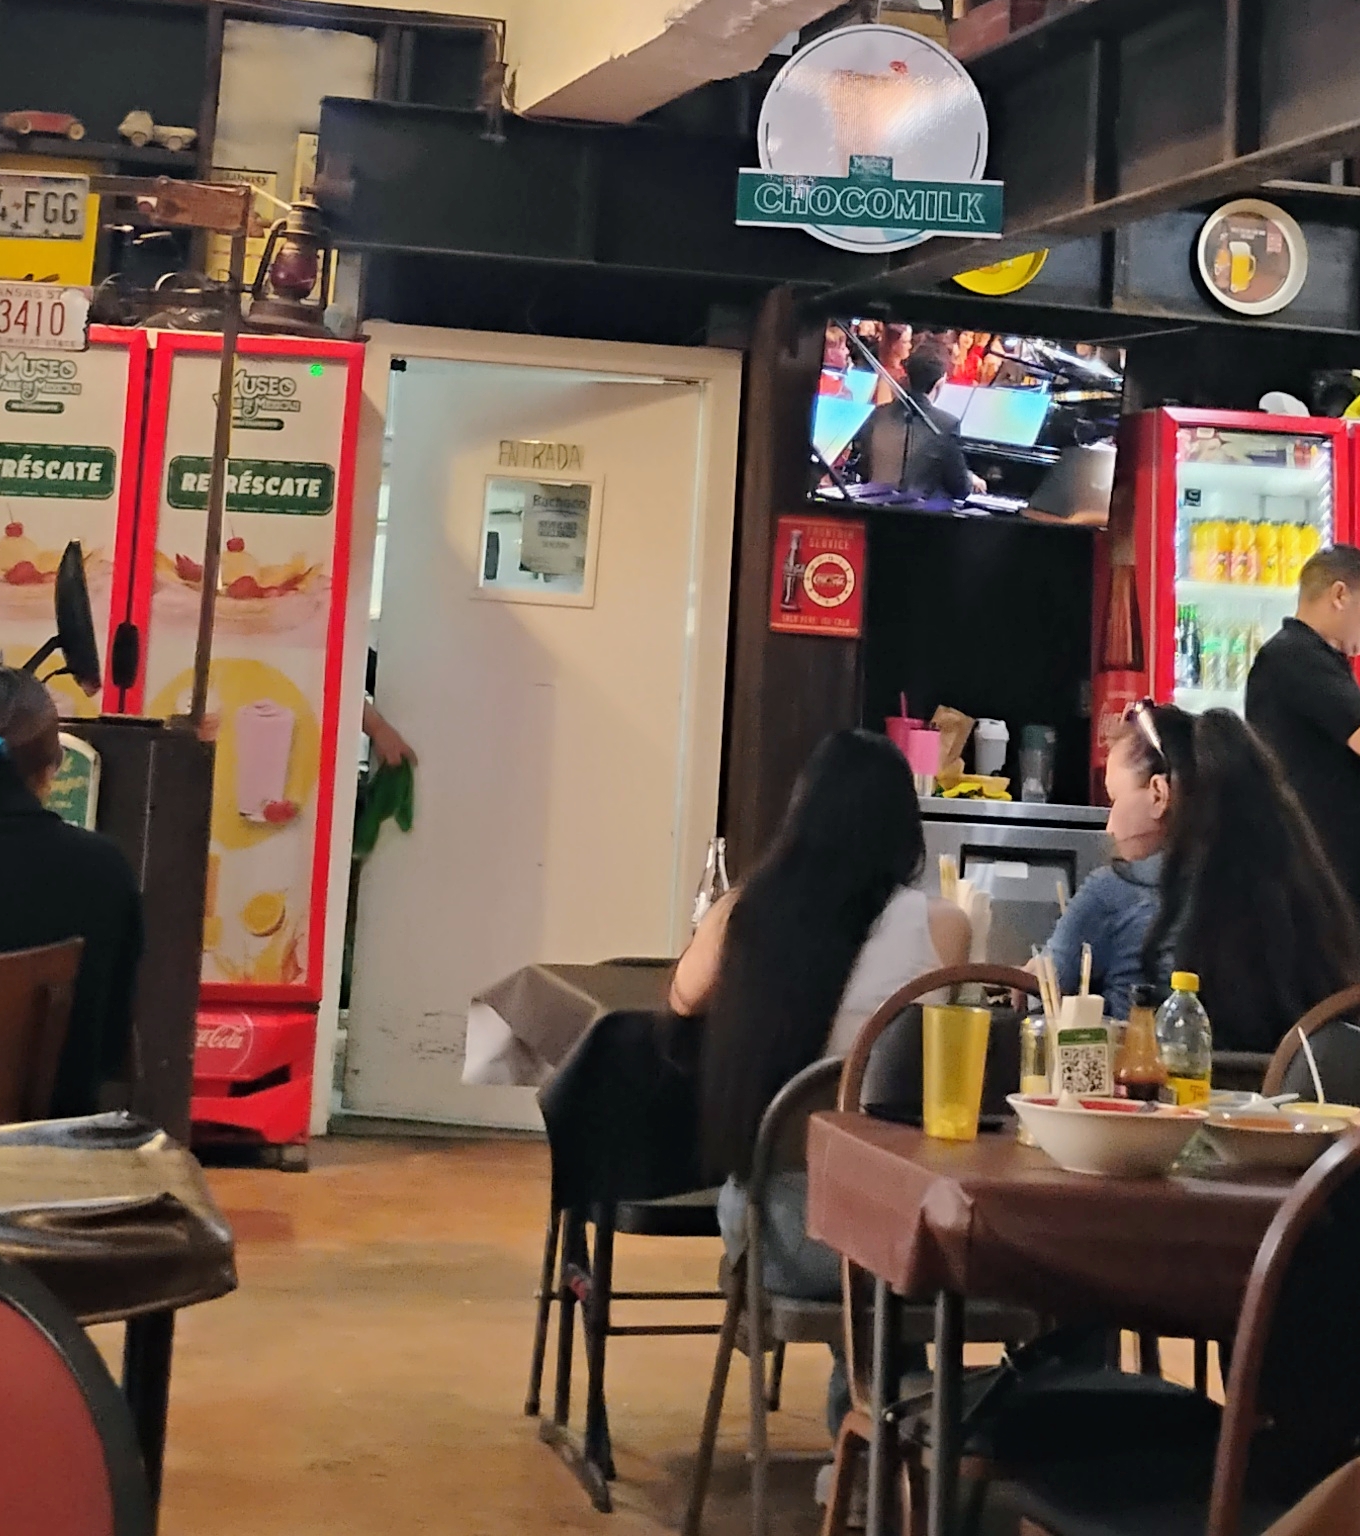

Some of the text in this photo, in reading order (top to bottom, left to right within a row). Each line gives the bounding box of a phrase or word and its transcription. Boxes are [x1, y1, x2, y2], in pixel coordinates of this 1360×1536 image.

[23, 190, 79, 225] FGG
[753, 181, 987, 225] CHOCOMILK
[498, 439, 582, 471] ENTRADA
[180, 470, 323, 498] RERÉSCATE
[809, 537, 850, 550] SERVICE
